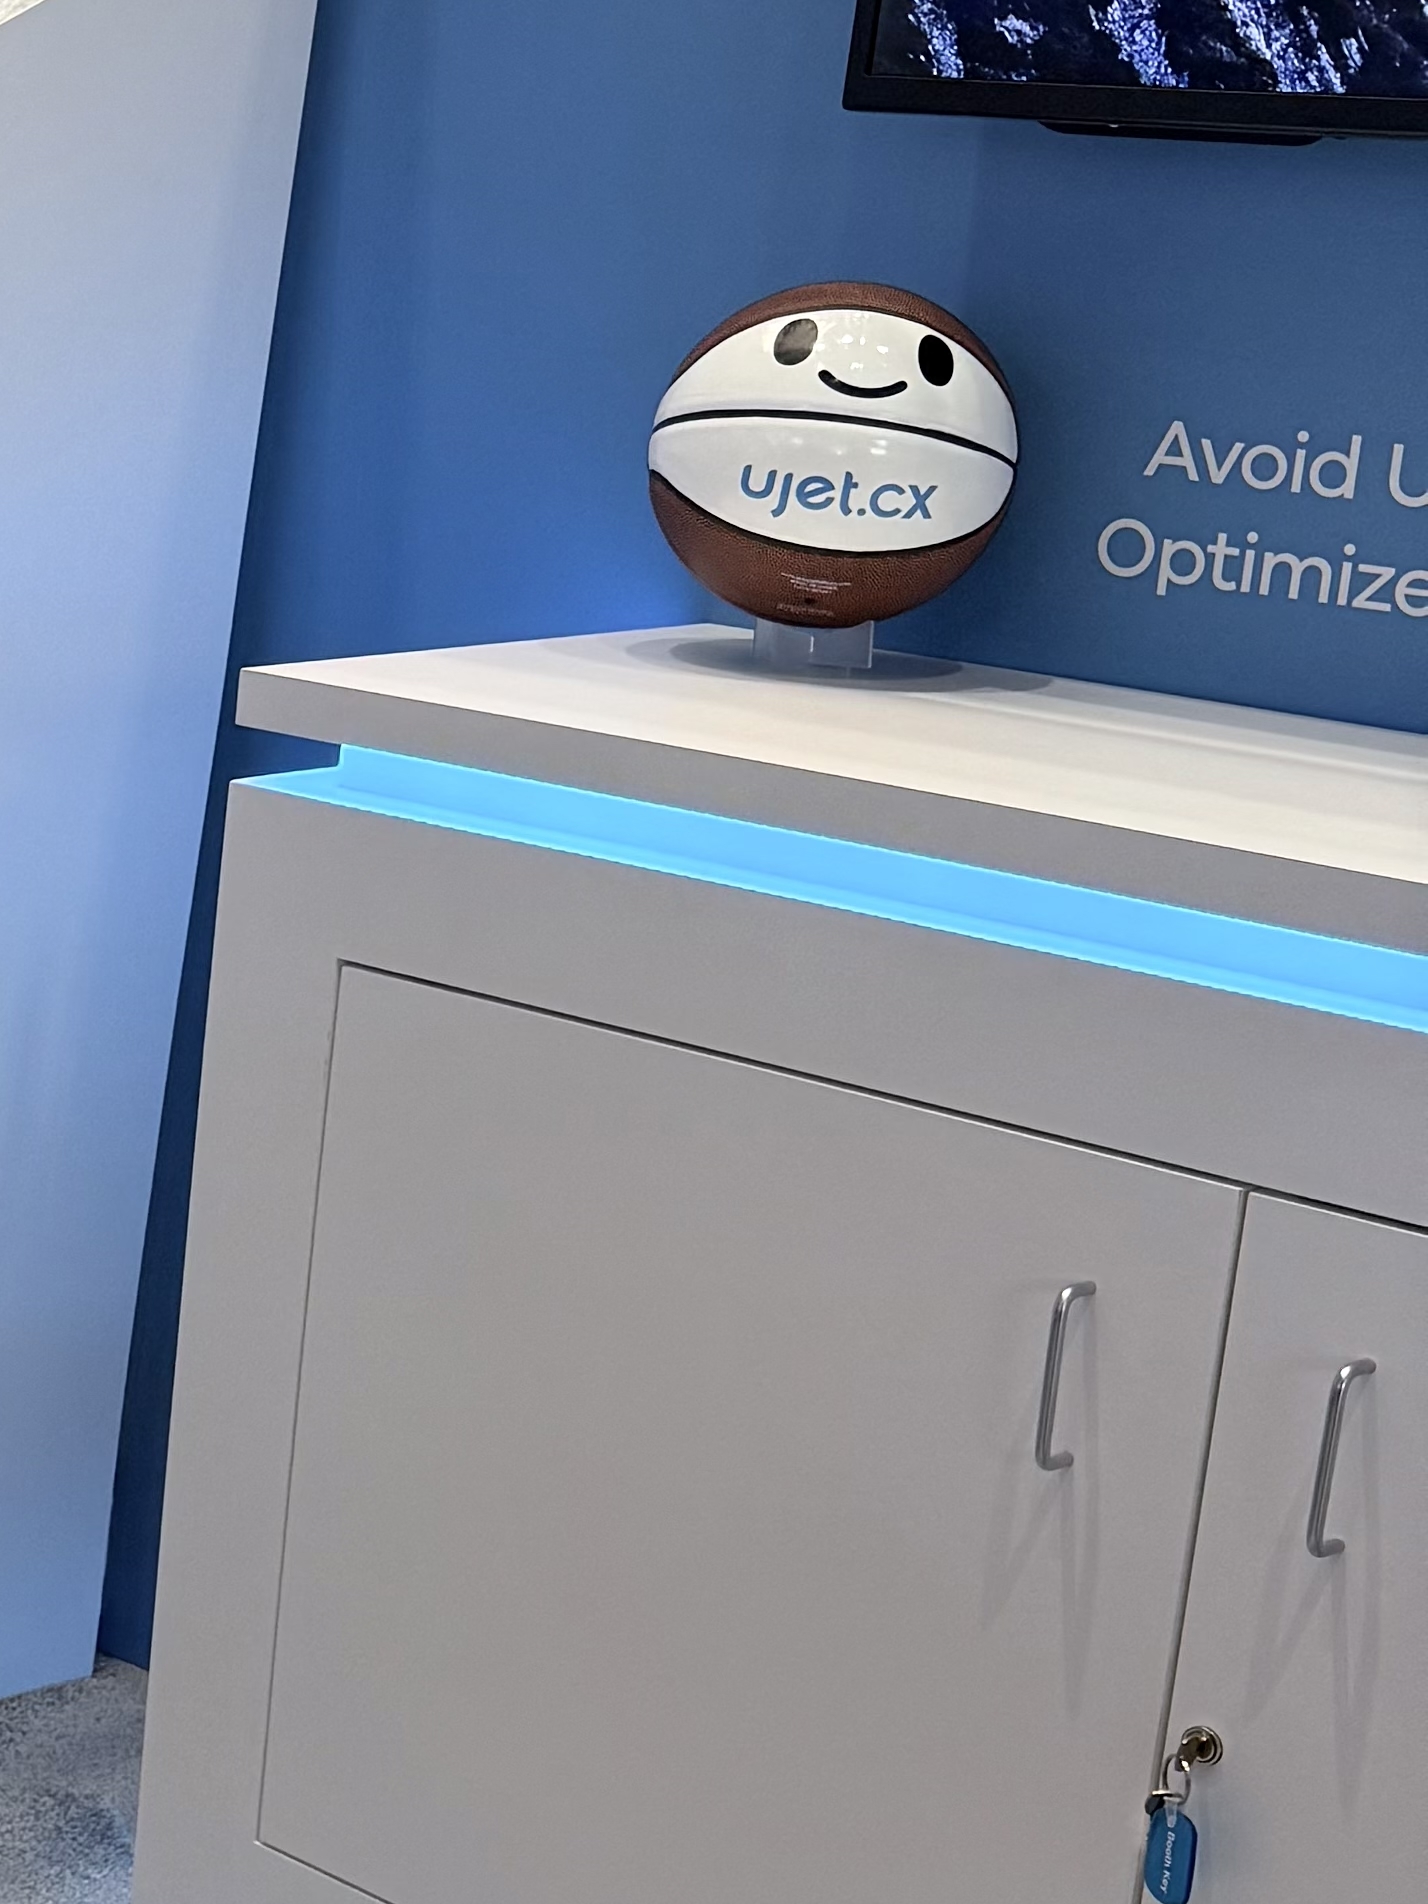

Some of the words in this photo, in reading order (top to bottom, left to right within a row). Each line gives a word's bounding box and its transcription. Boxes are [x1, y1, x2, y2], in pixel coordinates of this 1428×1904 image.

[740, 464, 937, 518] ujet.cx
[1143, 419, 1362, 500] Avoid
[1097, 517, 1428, 618] Optimize
